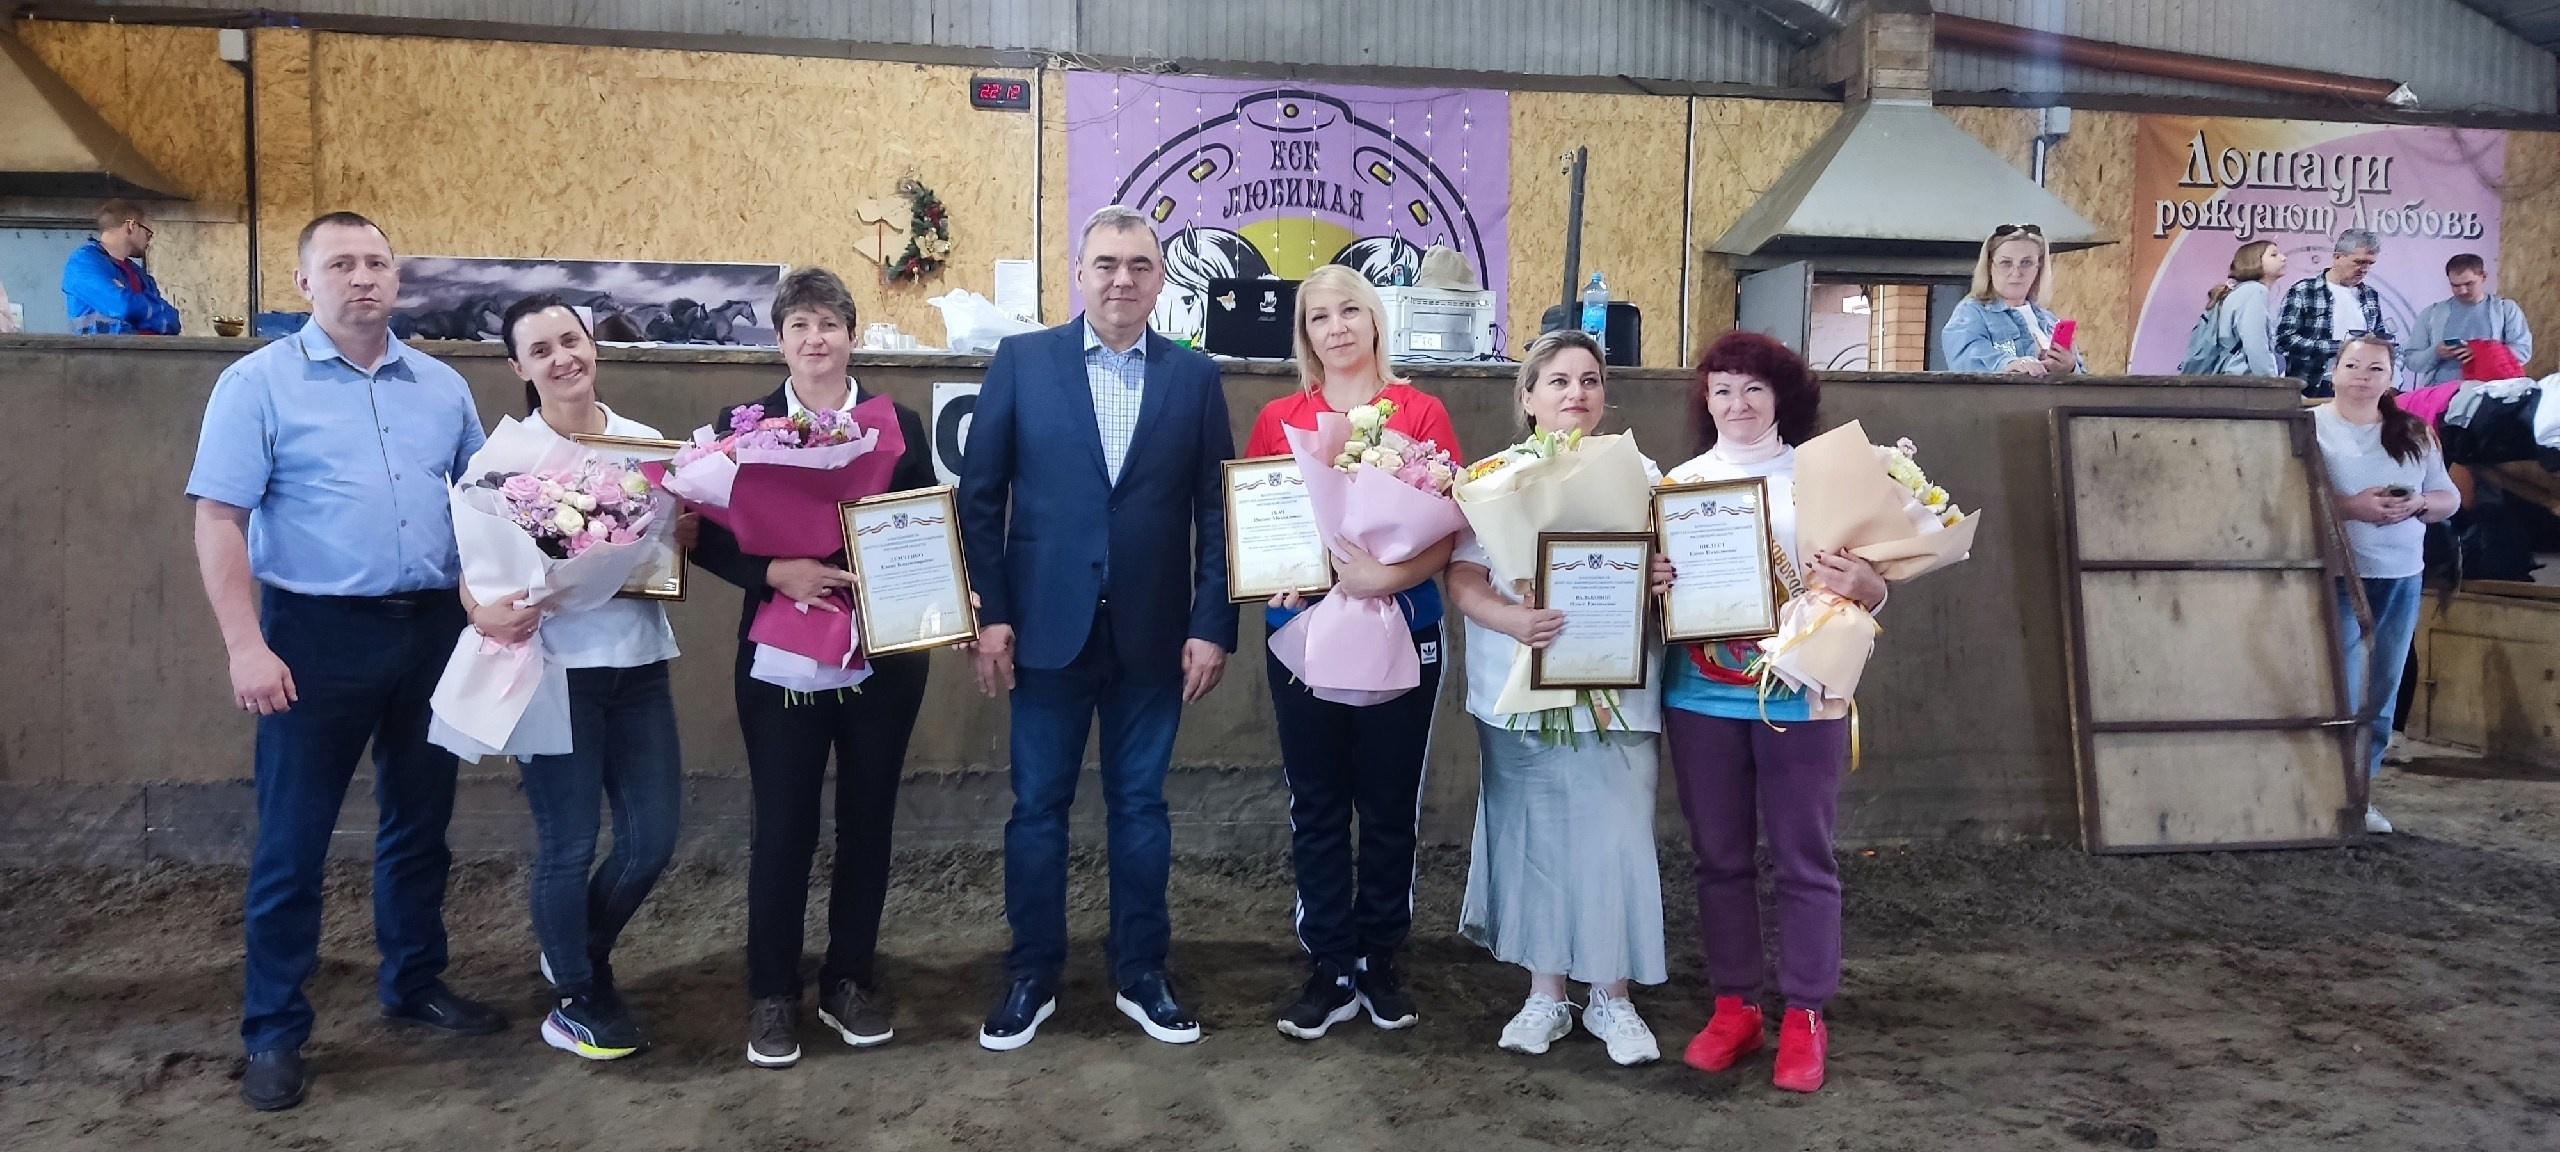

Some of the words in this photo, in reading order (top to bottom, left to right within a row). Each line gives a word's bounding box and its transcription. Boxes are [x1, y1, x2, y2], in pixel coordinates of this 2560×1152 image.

[1270, 140, 1321, 172] КСК
[2178, 129, 2394, 206] Лошади
[1222, 178, 1365, 222] ЛЮБИМАЯ
[2153, 198, 2336, 242] рождают
[2349, 195, 2484, 240] Любовь
